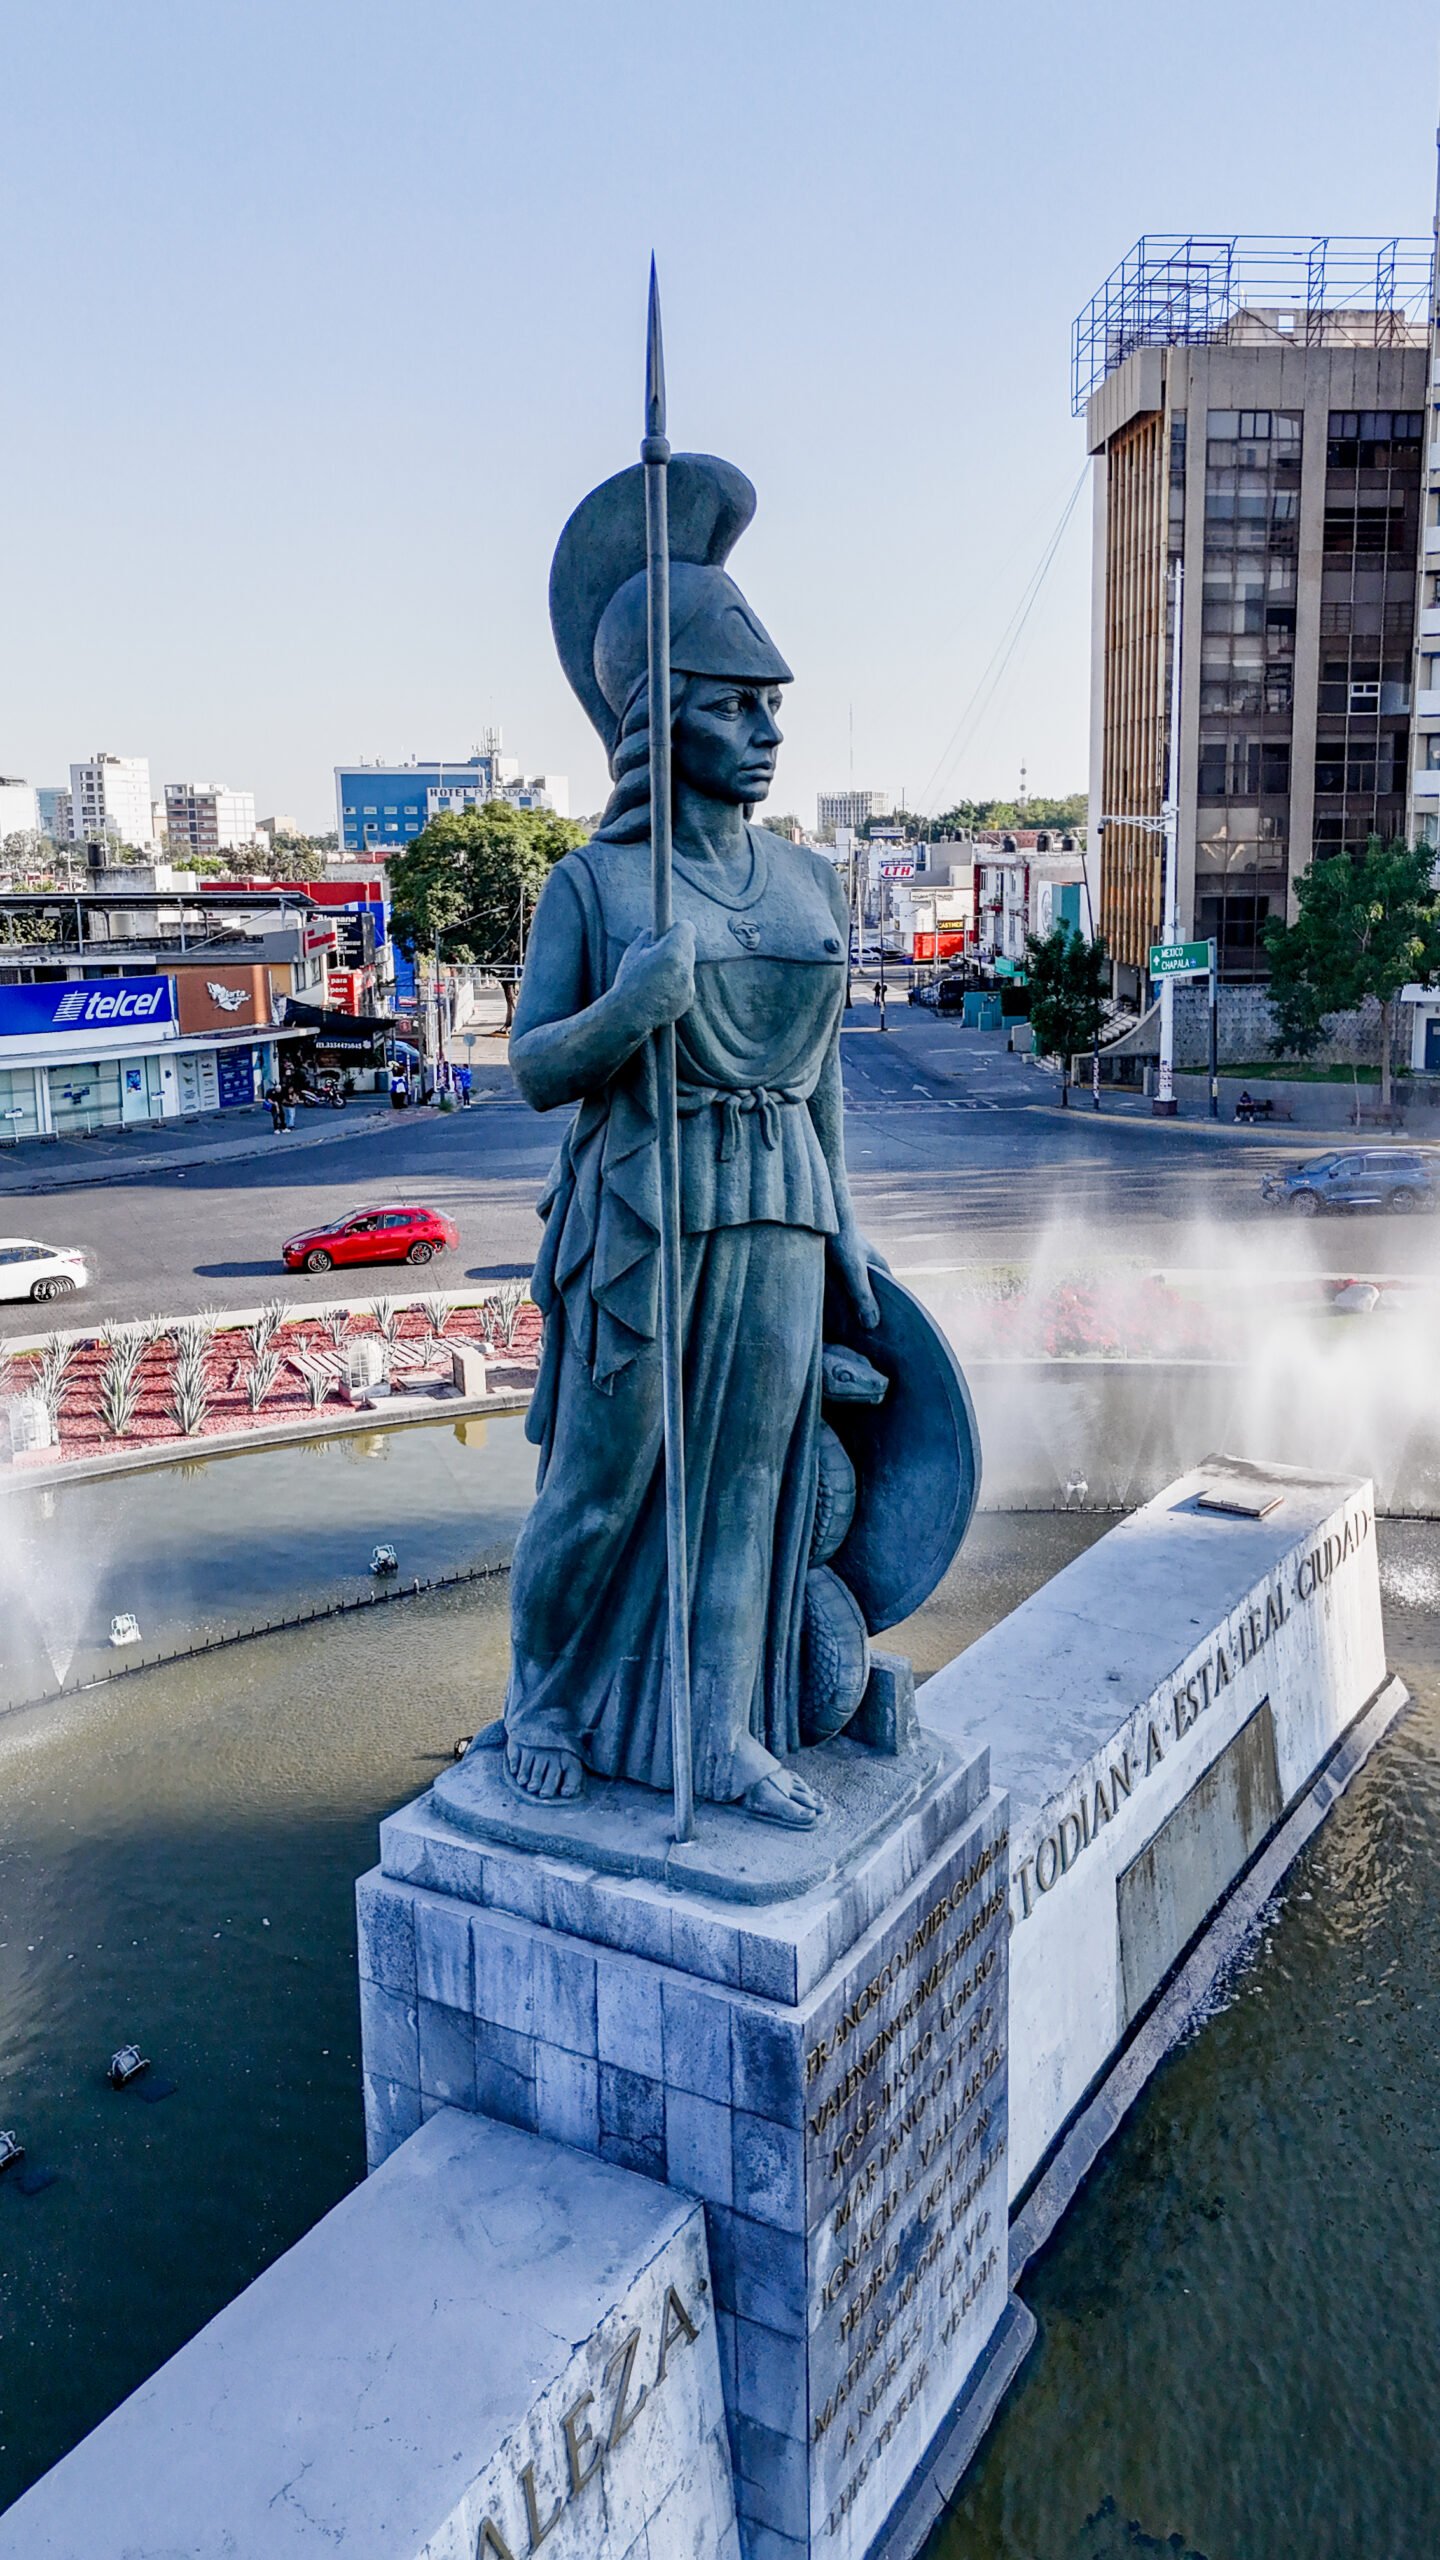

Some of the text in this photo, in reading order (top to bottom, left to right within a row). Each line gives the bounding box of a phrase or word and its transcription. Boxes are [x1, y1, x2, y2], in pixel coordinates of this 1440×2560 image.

[430, 788, 471, 797] HOTEL
[884, 866, 911, 876] LTH
[85, 987, 164, 1020] telcel
[1161, 947, 1184, 958] MEXICO
[1161, 958, 1190, 970] CHAPALA
[1146, 1720, 1165, 1777] A
[1173, 1646, 1232, 1742] ESTA
[1239, 1582, 1290, 1668] LEAL
[1298, 1510, 1369, 1600] CIUDAD
[951, 1830, 1008, 1909] GAMBOA
[810, 1886, 1005, 2135] VALENTIN GOMEZ FARIAS
[829, 1949, 995, 2181] JOSE JUSTO CORRO
[821, 2188, 898, 2311] IGNACIO
[919, 2045, 1000, 2167] VALLARTA
[834, 2094, 926, 2236] MARIANO
[837, 2105, 991, 2344] PEDRO OGAZON
[899, 2228, 945, 2311] MOTA
[951, 2137, 1006, 2230] PADILLA
[842, 2209, 990, 2460] ANDRES CAVO
[939, 2246, 997, 2348] VERDIA
